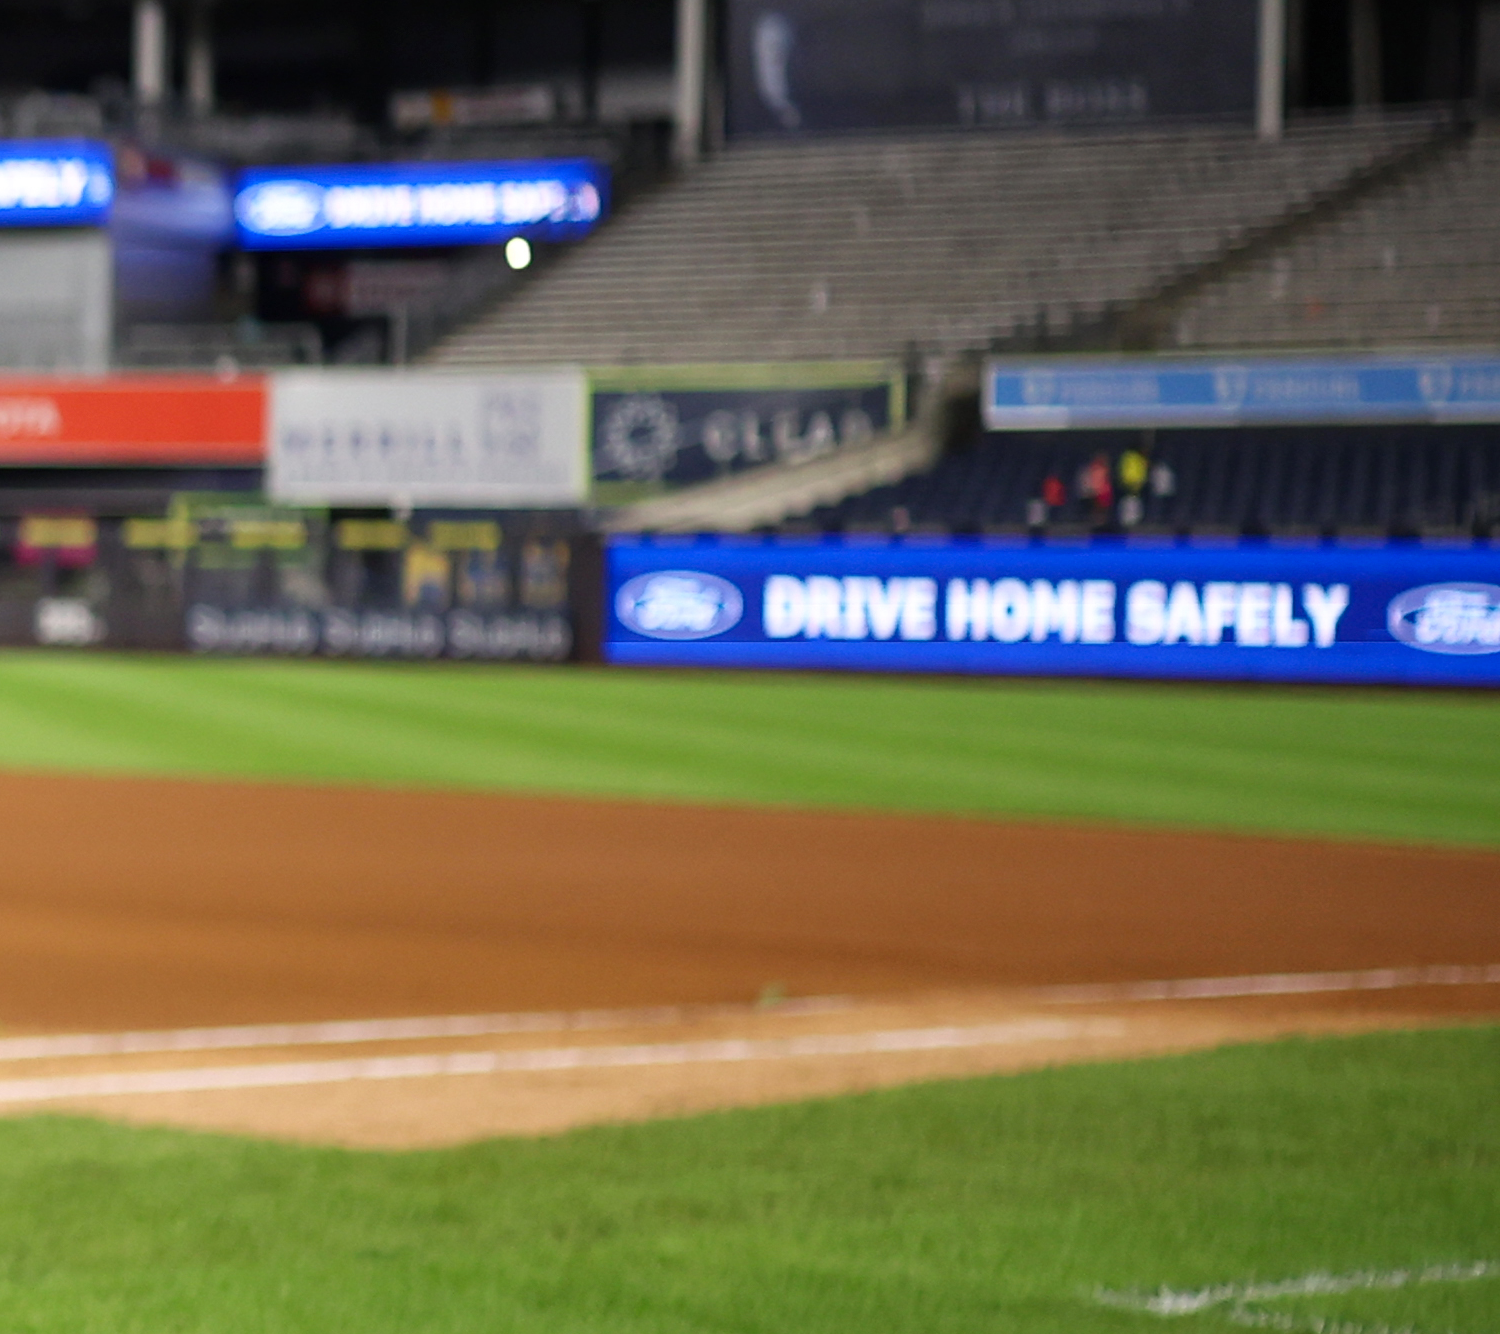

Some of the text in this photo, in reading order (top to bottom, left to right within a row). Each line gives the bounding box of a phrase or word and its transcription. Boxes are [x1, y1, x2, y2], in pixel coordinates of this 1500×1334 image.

[762, 574, 938, 642] DRIVE
[945, 577, 1117, 645] HOME
[1125, 581, 1351, 648] SAFELY
